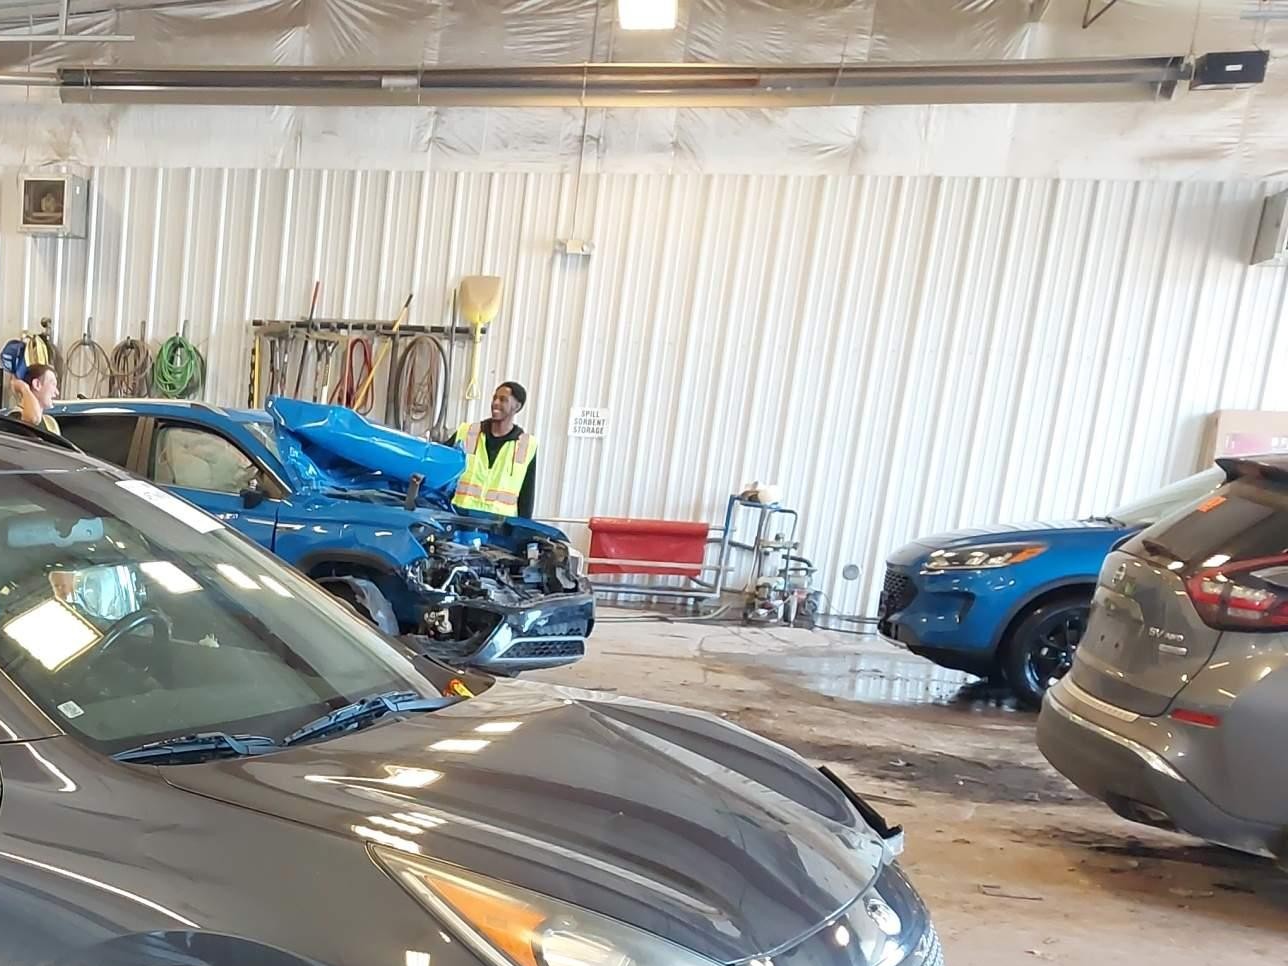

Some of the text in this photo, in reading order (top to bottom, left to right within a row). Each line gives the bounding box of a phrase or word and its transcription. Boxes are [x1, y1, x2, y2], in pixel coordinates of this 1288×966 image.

[581, 410, 600, 418] SPILL
[574, 417, 605, 426] SORBENT
[573, 426, 604, 434] STORAGE
[1148, 627, 1165, 638] SV
